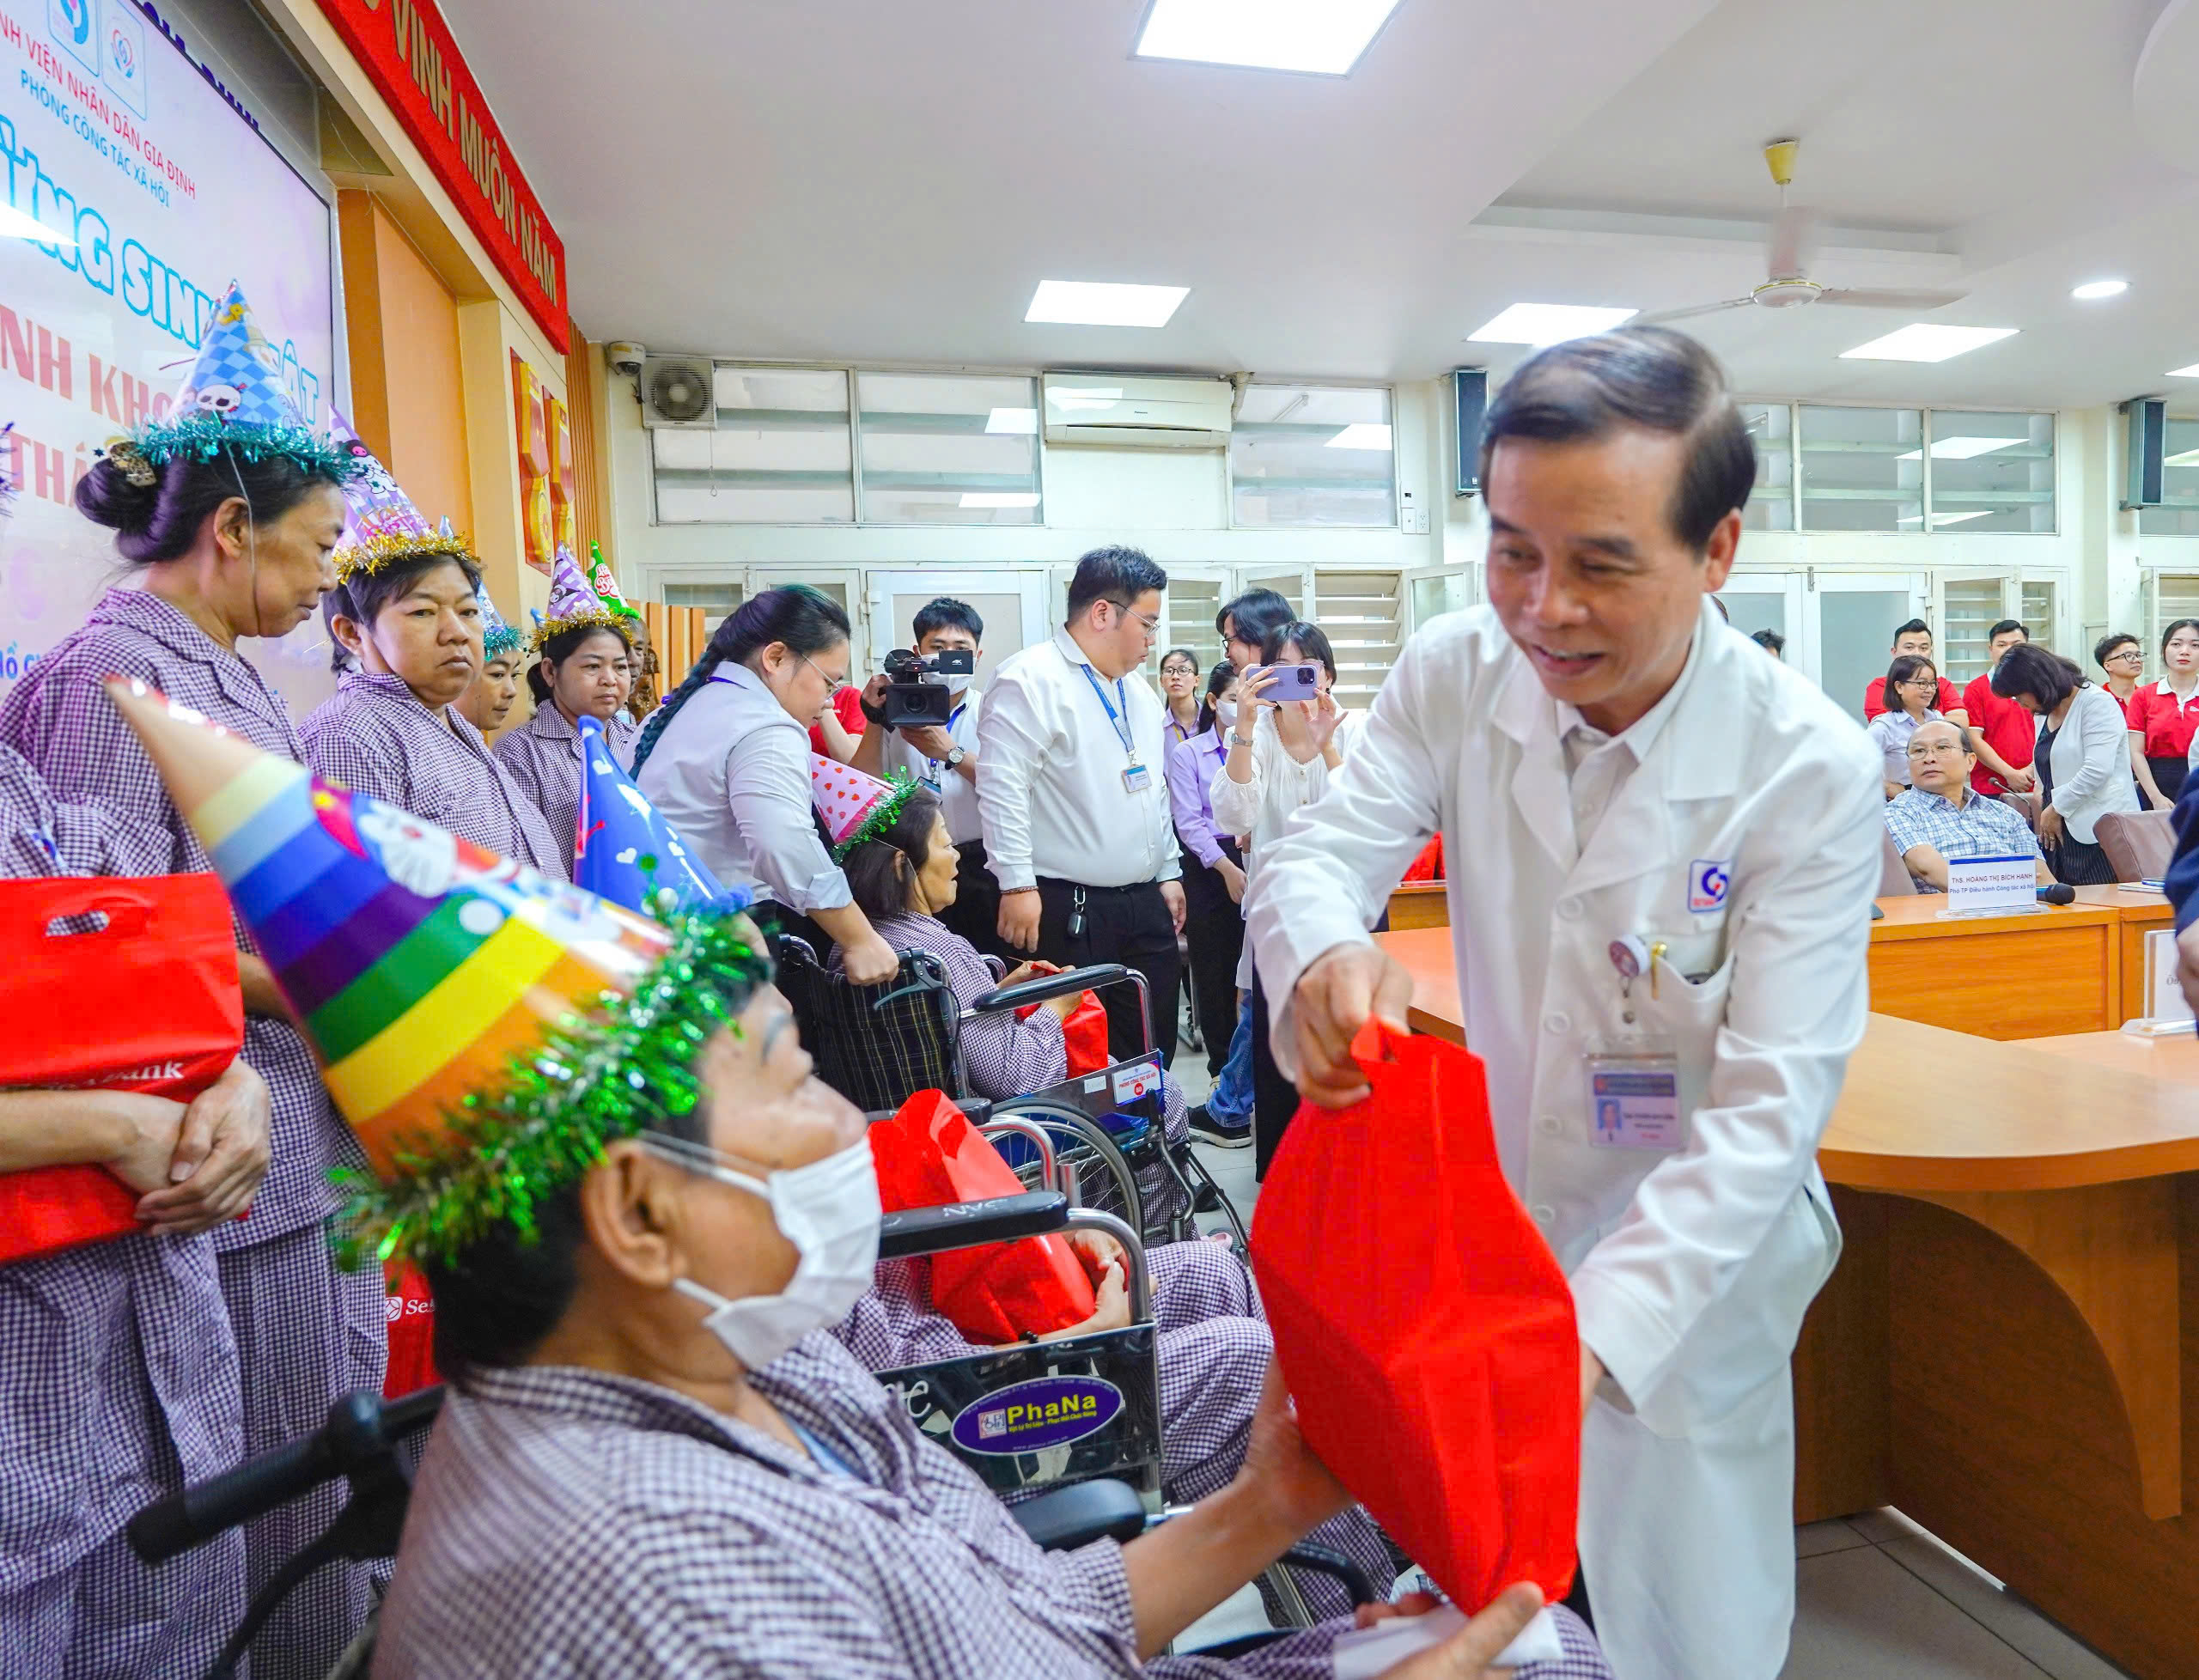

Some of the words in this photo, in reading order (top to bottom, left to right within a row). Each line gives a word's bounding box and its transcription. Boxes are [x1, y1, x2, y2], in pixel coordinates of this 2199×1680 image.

[20, 68, 70, 125] PHÒNG
[73, 114, 108, 157] CÔNG
[111, 143, 131, 176] TÁC
[133, 163, 149, 191] XÃ
[149, 179, 170, 209] HỘI
[26, 33, 64, 85] VIỆN
[67, 70, 110, 125] NHÂN
[113, 111, 141, 152] DÂN
[143, 140, 165, 173] GIA
[166, 159, 197, 200] ĐỊNH
[392, 0, 454, 144] VINH
[458, 90, 517, 248] MUÔN
[519, 202, 558, 308] NĂM
[2001, 873, 2015, 881] BÍCH
[1006, 1394, 1098, 1425] PhaNa
